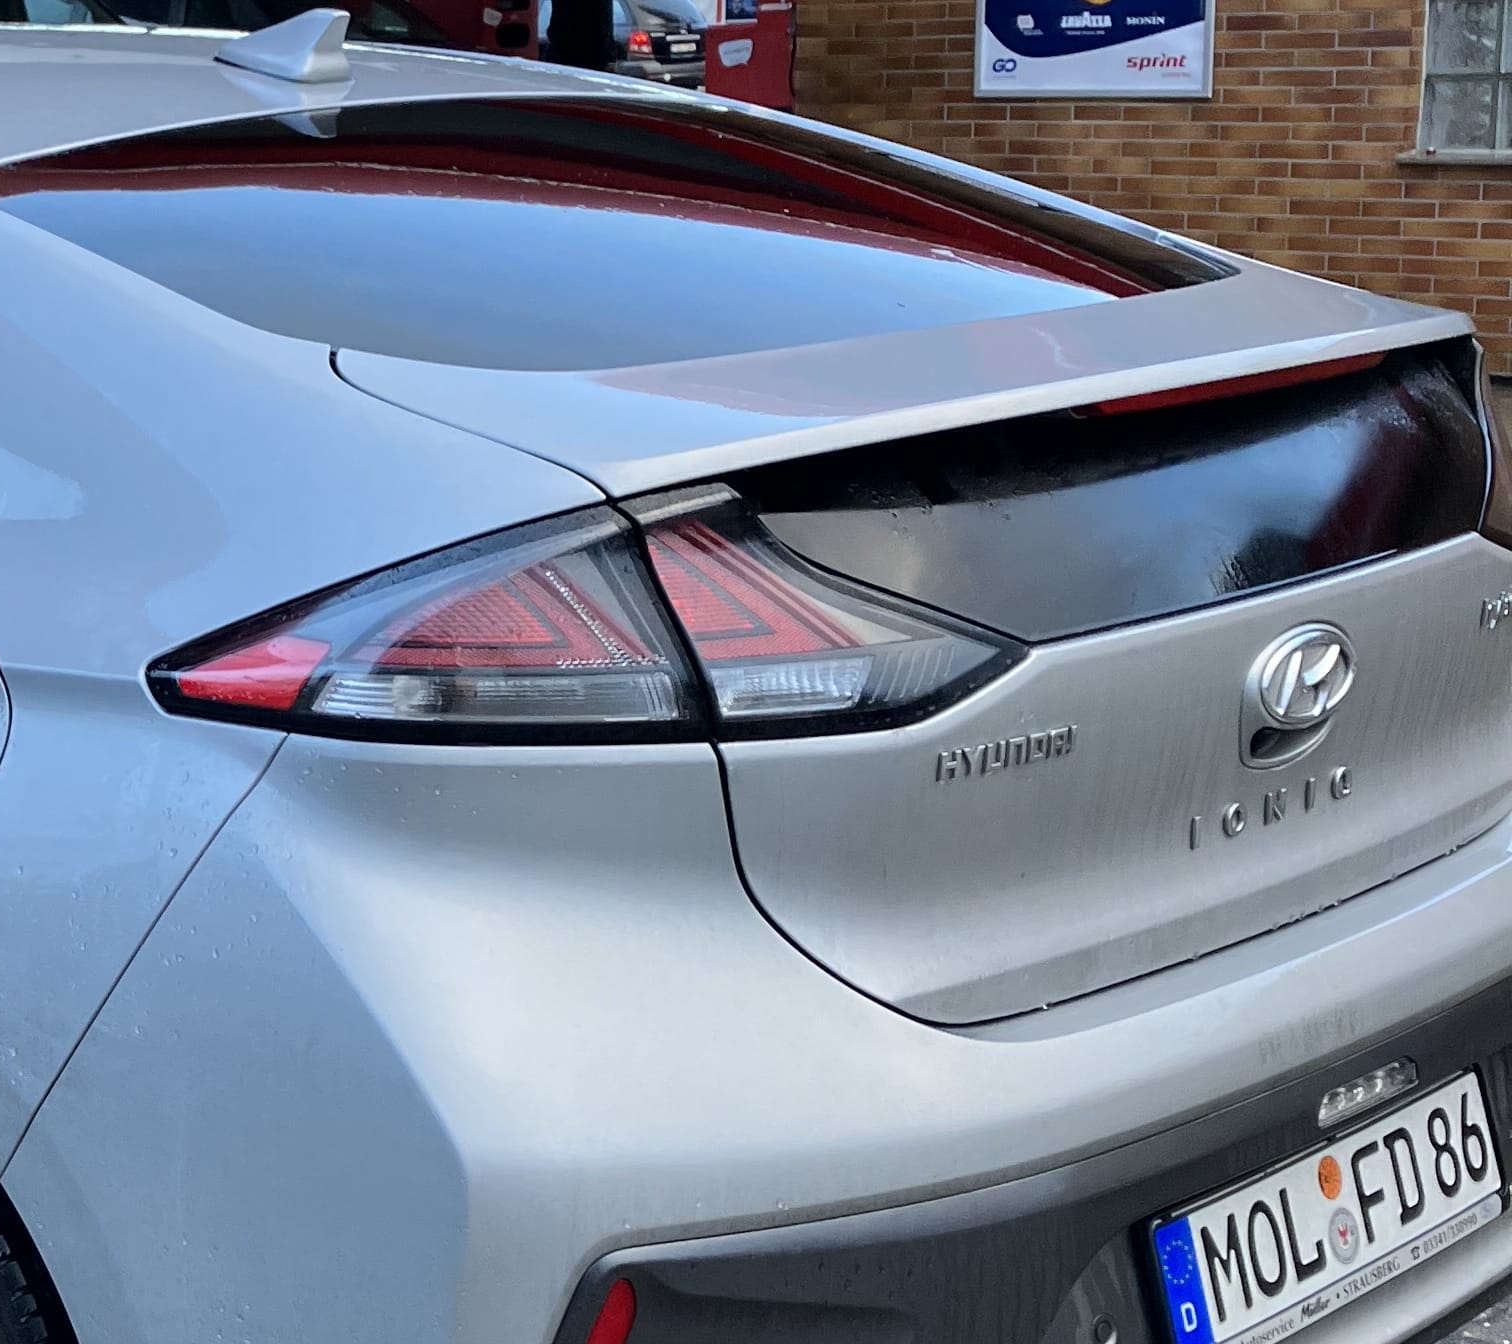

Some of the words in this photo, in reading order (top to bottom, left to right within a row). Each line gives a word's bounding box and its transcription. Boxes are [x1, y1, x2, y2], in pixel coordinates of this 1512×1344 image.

[1060, 11, 1113, 29] LAVAZZA
[1126, 15, 1166, 27] MONIN
[992, 58, 1017, 73] GO
[1126, 53, 1187, 72] sprint
[935, 723, 1079, 783] HYUNDAI
[1189, 764, 1354, 851] IONIQ
[1200, 1187, 1327, 1323] MOL
[1350, 1126, 1426, 1246] FD
[1427, 1092, 1489, 1198] 86
[1299, 1297, 1331, 1324] Müller
[1342, 1258, 1401, 1296] STRAUSBERG
[1179, 1301, 1199, 1333] D
